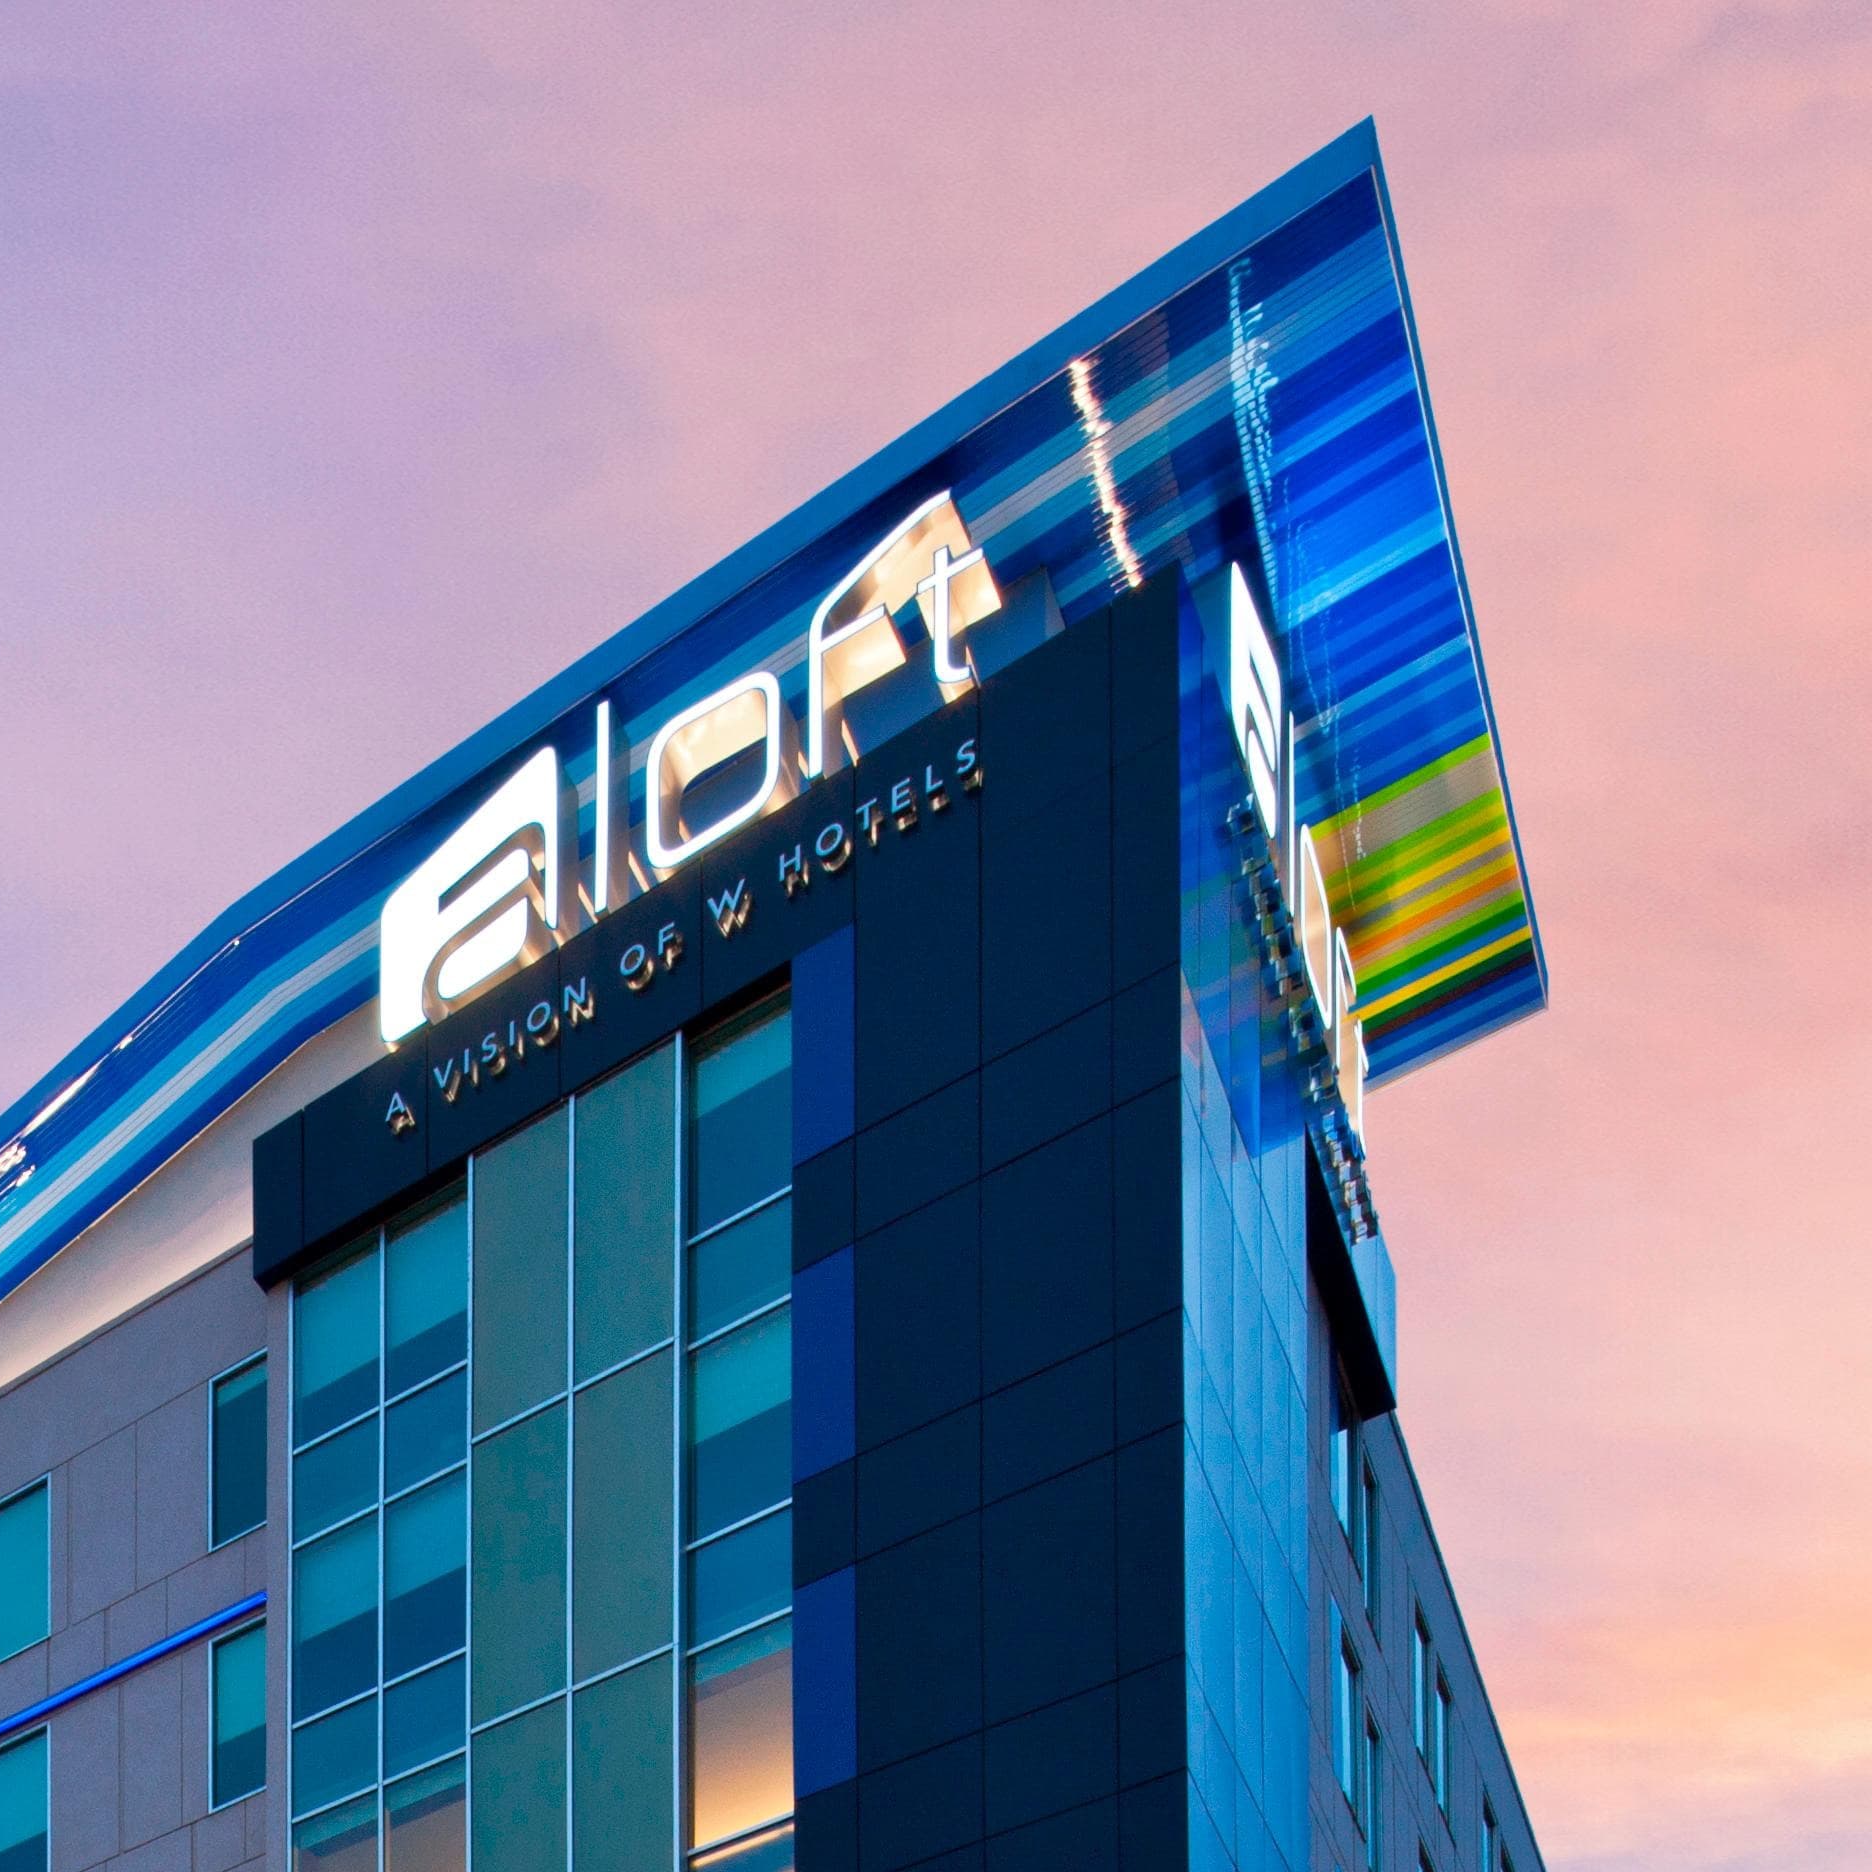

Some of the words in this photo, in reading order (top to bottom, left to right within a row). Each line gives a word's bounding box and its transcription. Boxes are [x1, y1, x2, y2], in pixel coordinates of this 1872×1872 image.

[380, 489, 983, 1044] aloft
[385, 1091, 407, 1123] A
[433, 976, 587, 1089] VISION
[619, 922, 676, 977] OF
[707, 878, 746, 921] W
[779, 739, 976, 883] HOTELS
